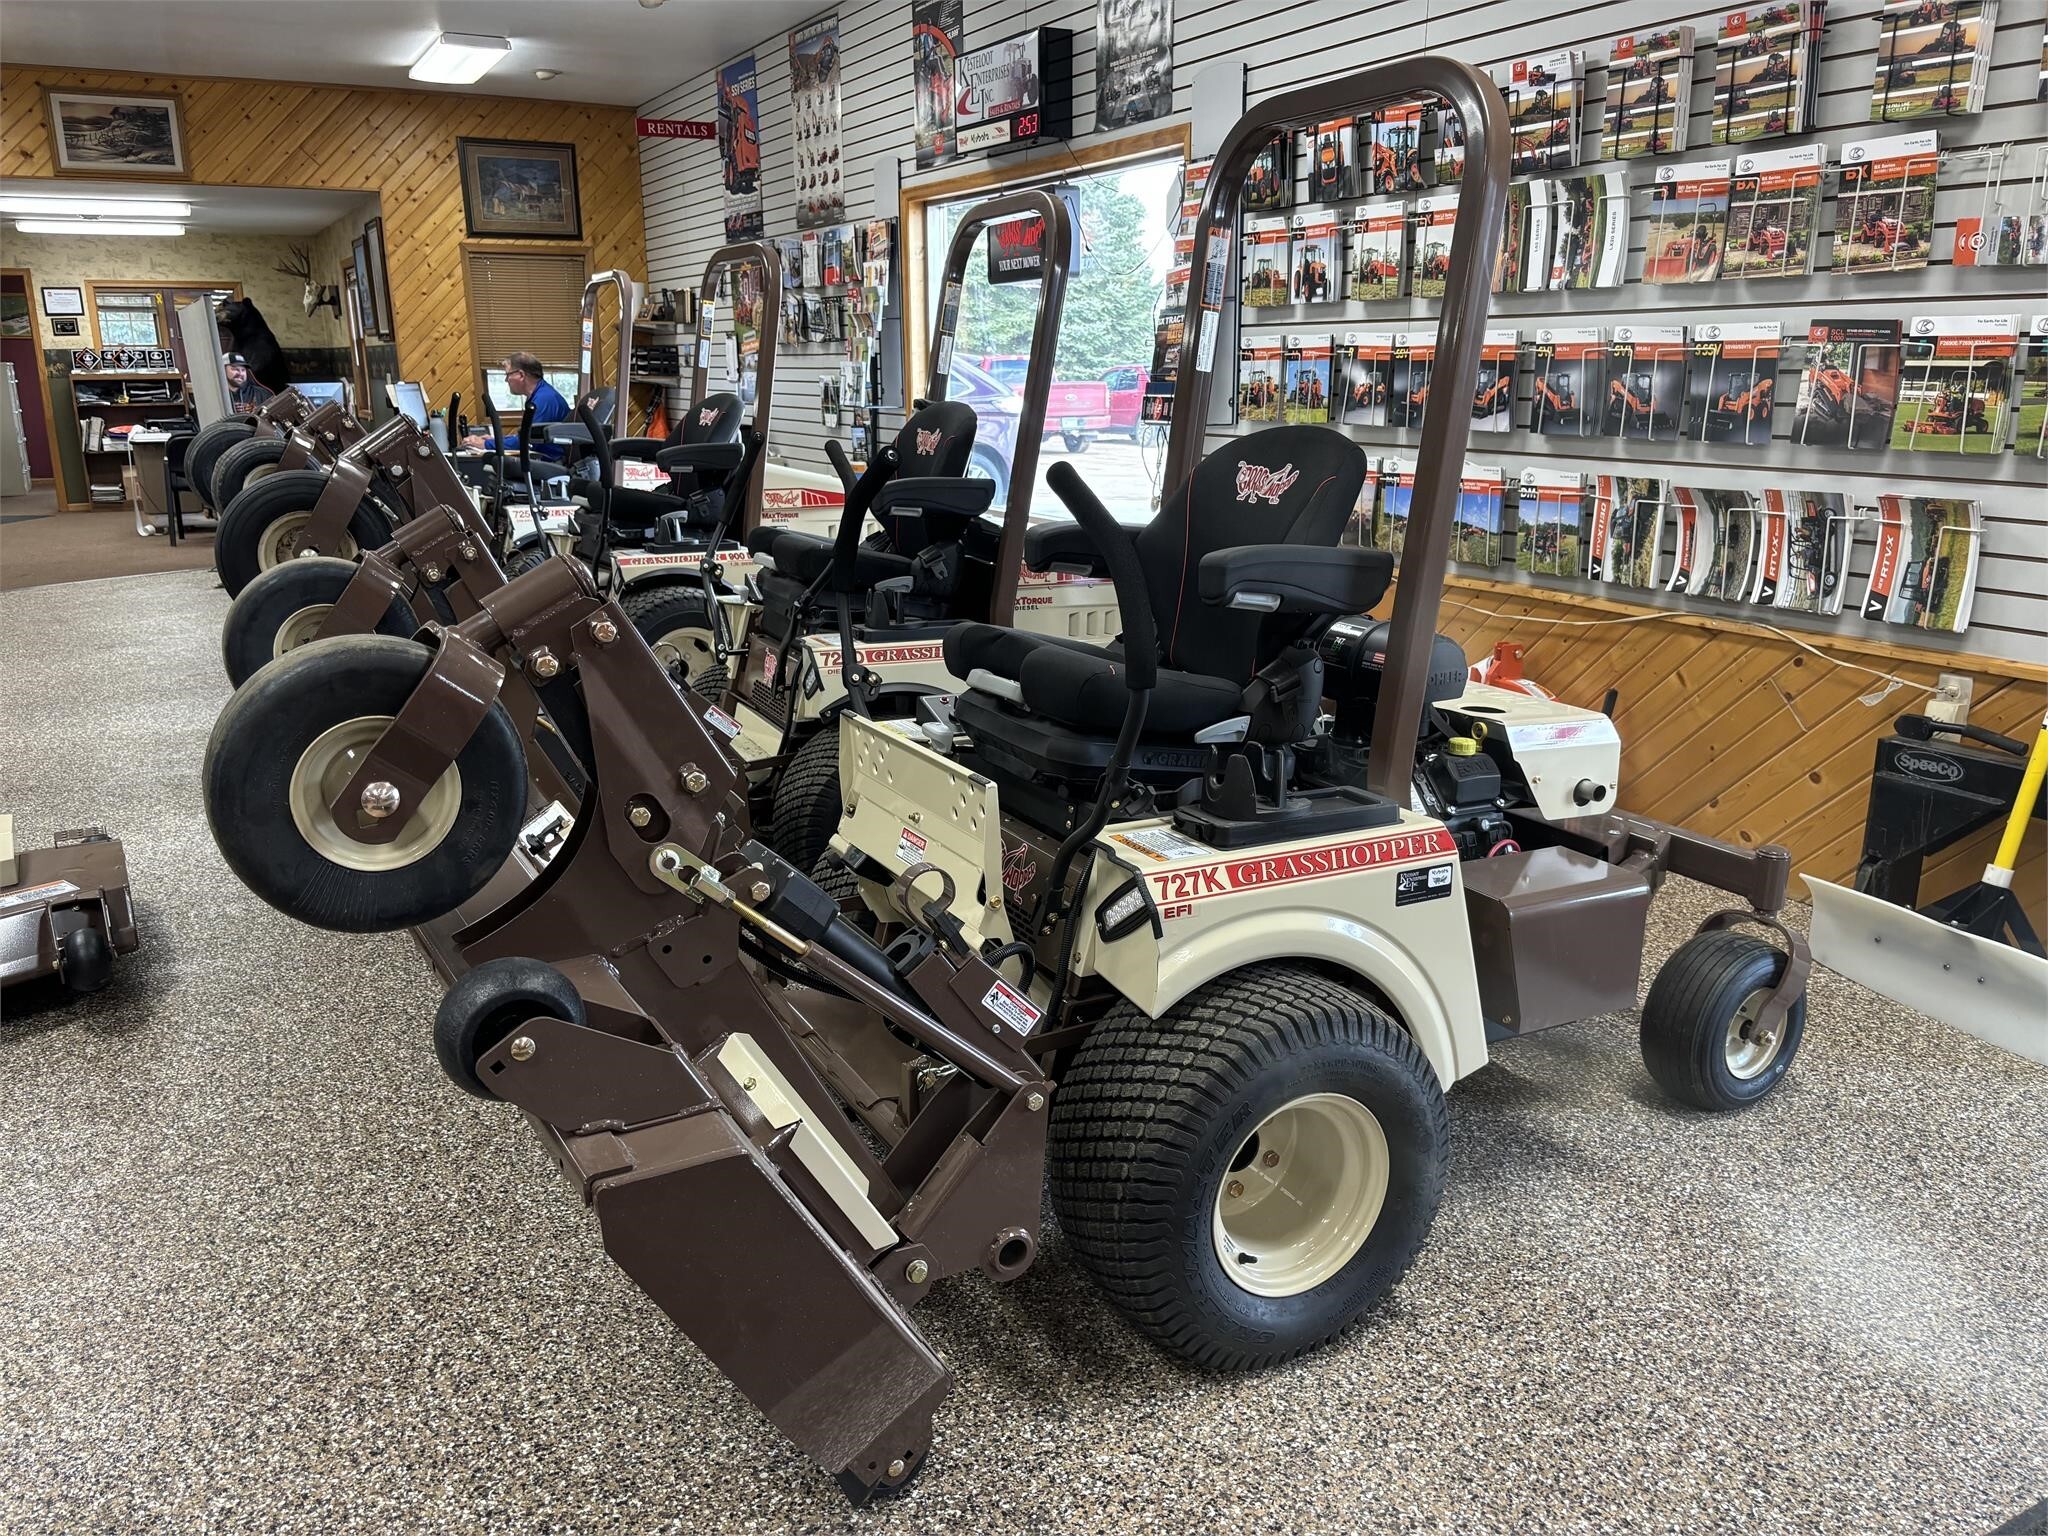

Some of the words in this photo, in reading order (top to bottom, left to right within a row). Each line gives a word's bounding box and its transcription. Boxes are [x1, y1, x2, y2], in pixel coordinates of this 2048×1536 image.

[958, 50, 994, 88] KESTELOOT
[970, 63, 1010, 105] ENTERPRISES
[647, 122, 708, 137] RENTALS
[1018, 113, 1038, 137] 2:53
[999, 260, 1010, 271] YOUR
[1010, 258, 1022, 269] NEXT
[1022, 255, 1040, 268] MOWER
[1520, 487, 1536, 499] DM
[1014, 597, 1053, 605] XTORQUE
[820, 651, 865, 666] 72D
[872, 646, 943, 662] GRASSH
[1428, 670, 1464, 688] OHLER
[1153, 866, 1227, 901] 727K
[1236, 832, 1442, 885] GRASSHOPPER
[1164, 903, 1193, 919] EFI
